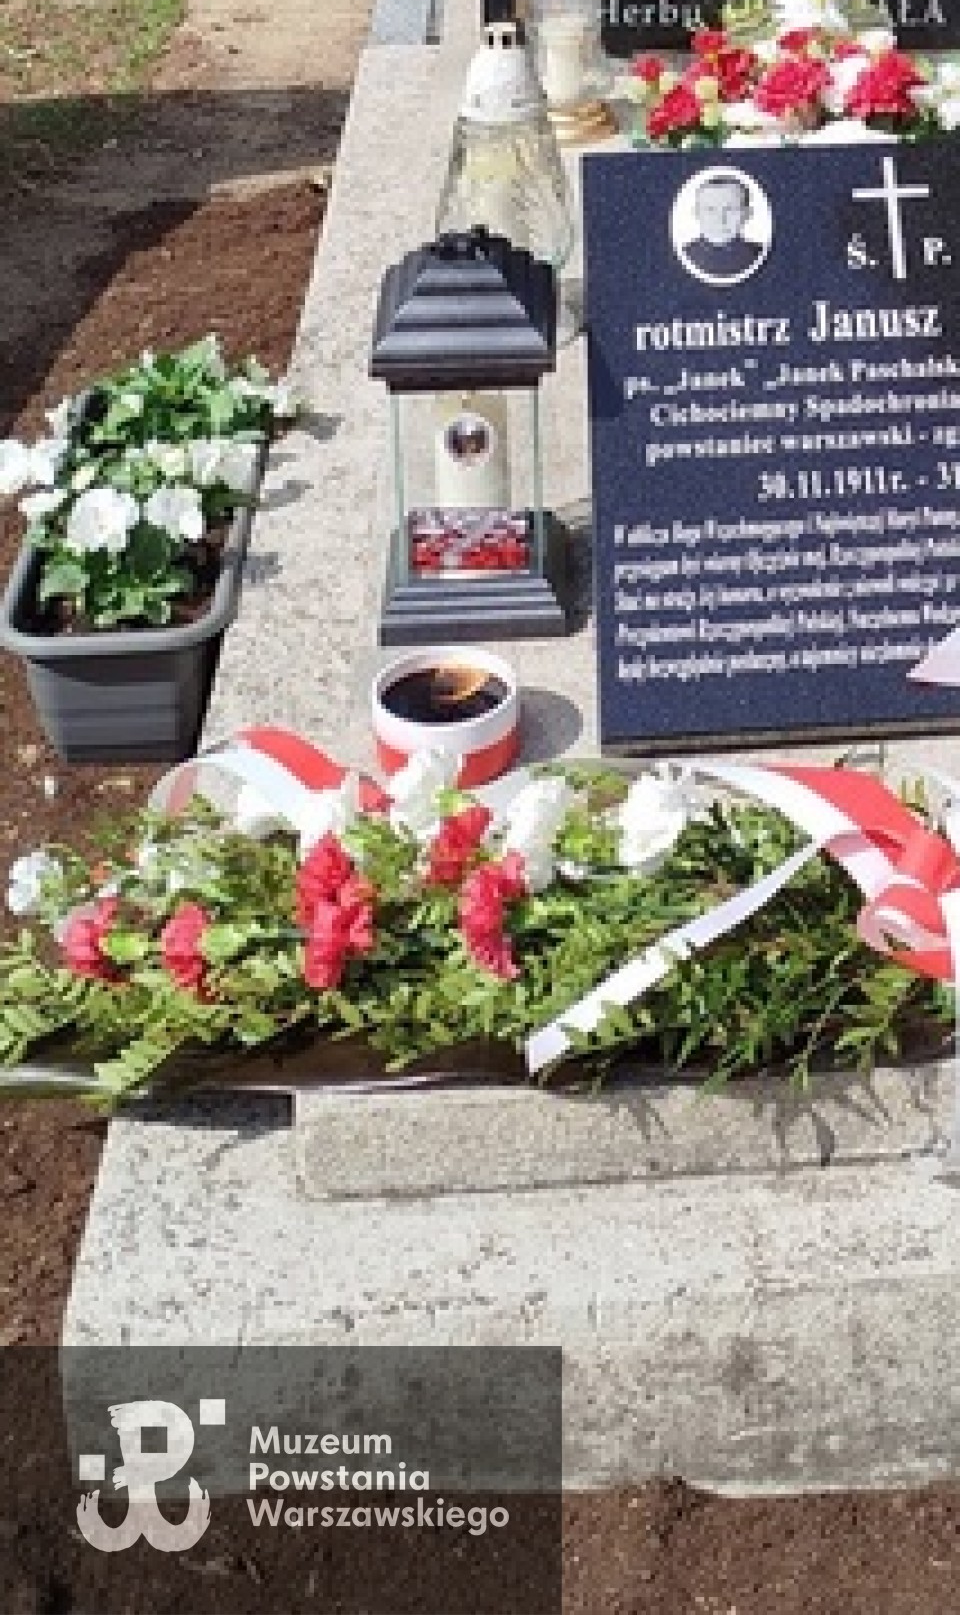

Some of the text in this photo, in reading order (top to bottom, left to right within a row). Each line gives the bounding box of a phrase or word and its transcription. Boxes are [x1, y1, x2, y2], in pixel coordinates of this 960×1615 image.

[635, 311, 790, 351] rotmistrz
[808, 300, 941, 342] Janusz
[650, 395, 798, 427] Cichociemny
[646, 431, 776, 467] powstaniec
[781, 422, 913, 453] warszawski
